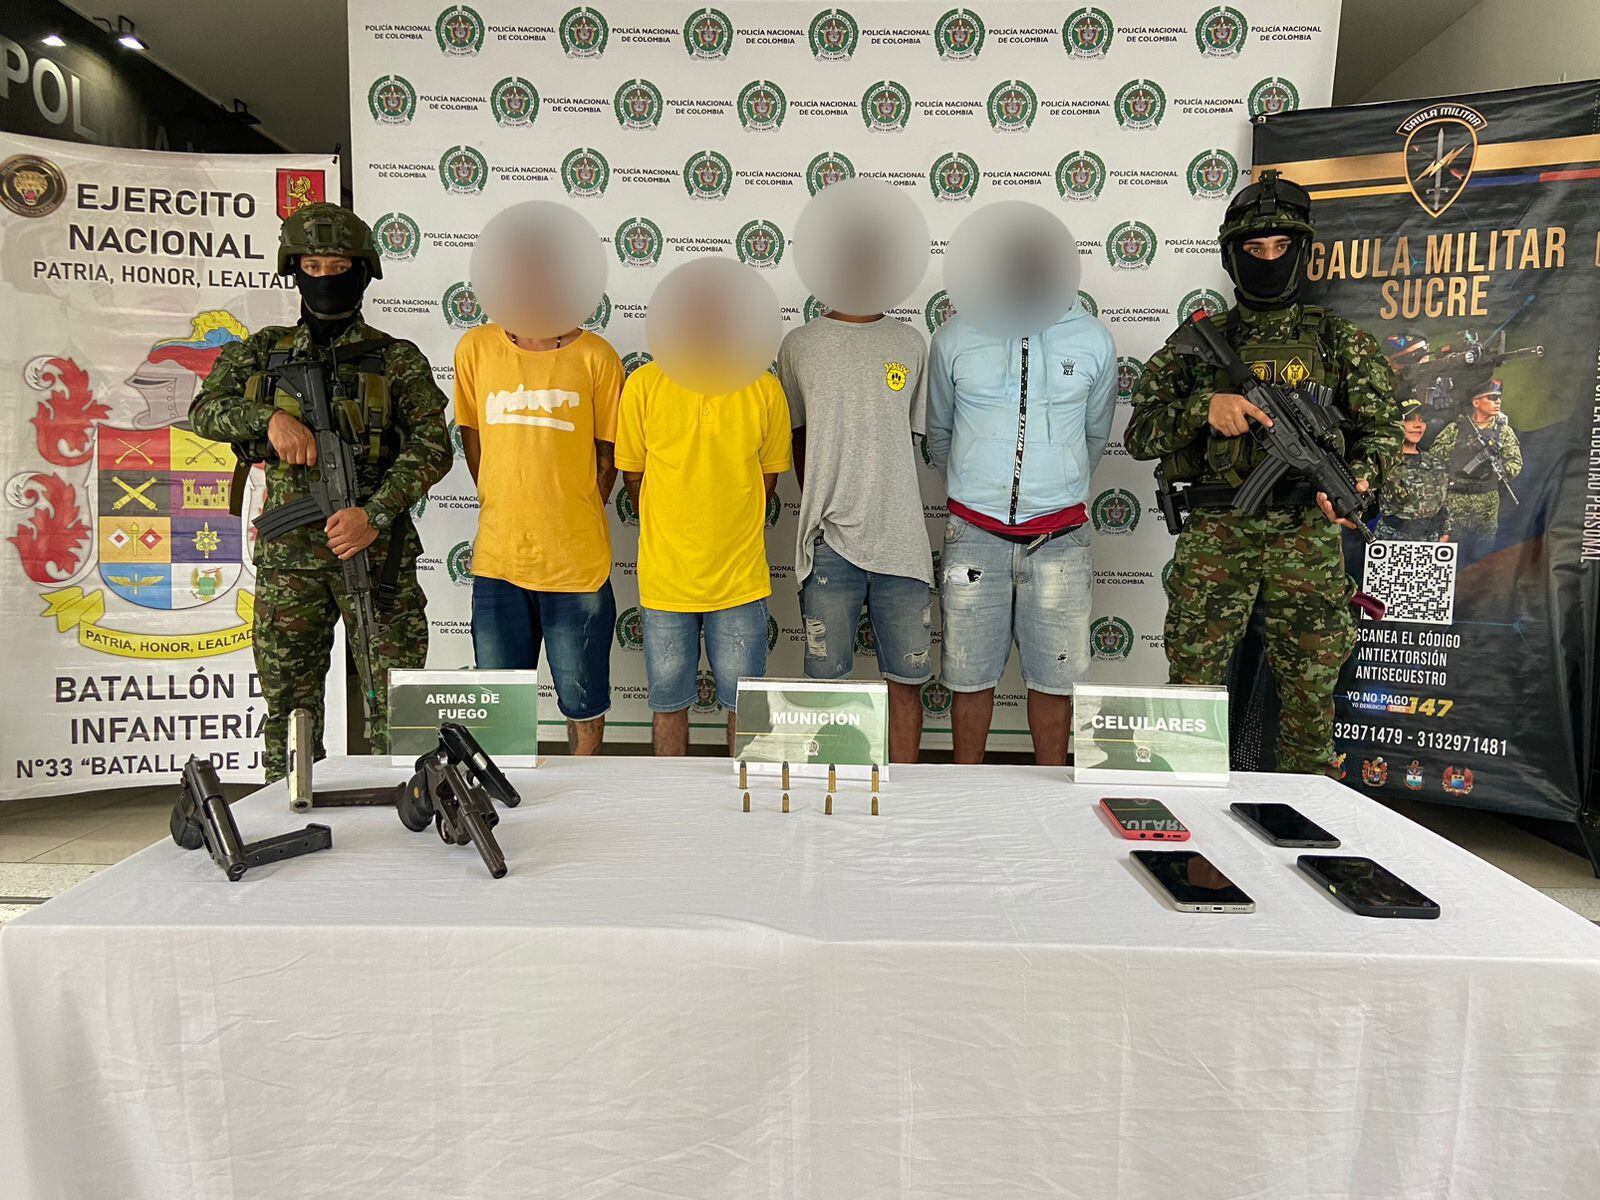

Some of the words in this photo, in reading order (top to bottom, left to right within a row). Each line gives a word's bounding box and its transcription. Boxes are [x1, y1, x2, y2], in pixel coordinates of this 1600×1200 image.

[488, 25, 516, 33] POLICÍA
[737, 28, 766, 36] POLICÍA
[862, 28, 891, 36] POLICÍA
[989, 27, 1018, 36] POLICÍA
[1118, 26, 1147, 34] POLICÍA
[1251, 25, 1281, 33] POLICÍA
[1282, 25, 1322, 33] NACIONAL
[1009, 36, 1049, 44] COLOMBIA
[666, 99, 695, 107] POLICÍA
[790, 100, 818, 108] POLICÍA
[915, 100, 944, 108] POLICÍA
[1041, 99, 1070, 107] POLICÍA
[1174, 97, 1203, 105] POLICÍA
[1204, 98, 1244, 106] NACIONAL
[1403, 109, 1438, 131] GAULA
[1440, 107, 1482, 127] MILITAR
[983, 170, 1012, 178] POLICÍA
[77, 183, 256, 219] EJERCITO
[69, 223, 265, 260] NACIONAL
[1165, 238, 1194, 246] POLICÍA
[1306, 235, 1411, 282] GAULA
[1424, 226, 1567, 275] MILITAR
[33, 260, 114, 285] PATRIA,
[122, 265, 201, 289] HONOR,
[208, 270, 296, 290] LEALTAD
[1379, 275, 1491, 320] SUCRE
[1102, 307, 1131, 315] POLICÍA
[1017, 412, 1026, 452] WHITE
[1580, 494, 1600, 563] PERSONAL
[1092, 570, 1116, 578] OLICÍA
[86, 630, 136, 652] PATRIA,
[140, 642, 193, 653] HONOR,
[198, 629, 253, 651] LEALTAD
[1355, 628, 1398, 644] SCANEA
[1401, 631, 1415, 646] EL
[1418, 630, 1461, 649] CÓDIGO
[1357, 647, 1448, 667] ANTIEXTORSIÓN
[1355, 665, 1447, 686] ANTISECUESTRO
[55, 666, 234, 703] BATALLÓN
[249, 673, 265, 699] D
[425, 693, 477, 704] ARMAS
[480, 693, 500, 704] DE
[1346, 691, 1360, 702] YO
[1362, 692, 1378, 703] NO
[1380, 694, 1409, 706] PAGO
[438, 708, 488, 719] FUEGO
[1409, 696, 1454, 717] 147
[71, 706, 269, 744] INFANTERÍA
[772, 710, 861, 726] MUNICIÓN
[1091, 715, 1207, 733] CELULARES
[1334, 722, 1403, 745] 32971479
[1417, 731, 1507, 756] 3132971481
[81, 754, 186, 776] “BATALL
[209, 752, 240, 770] DE
